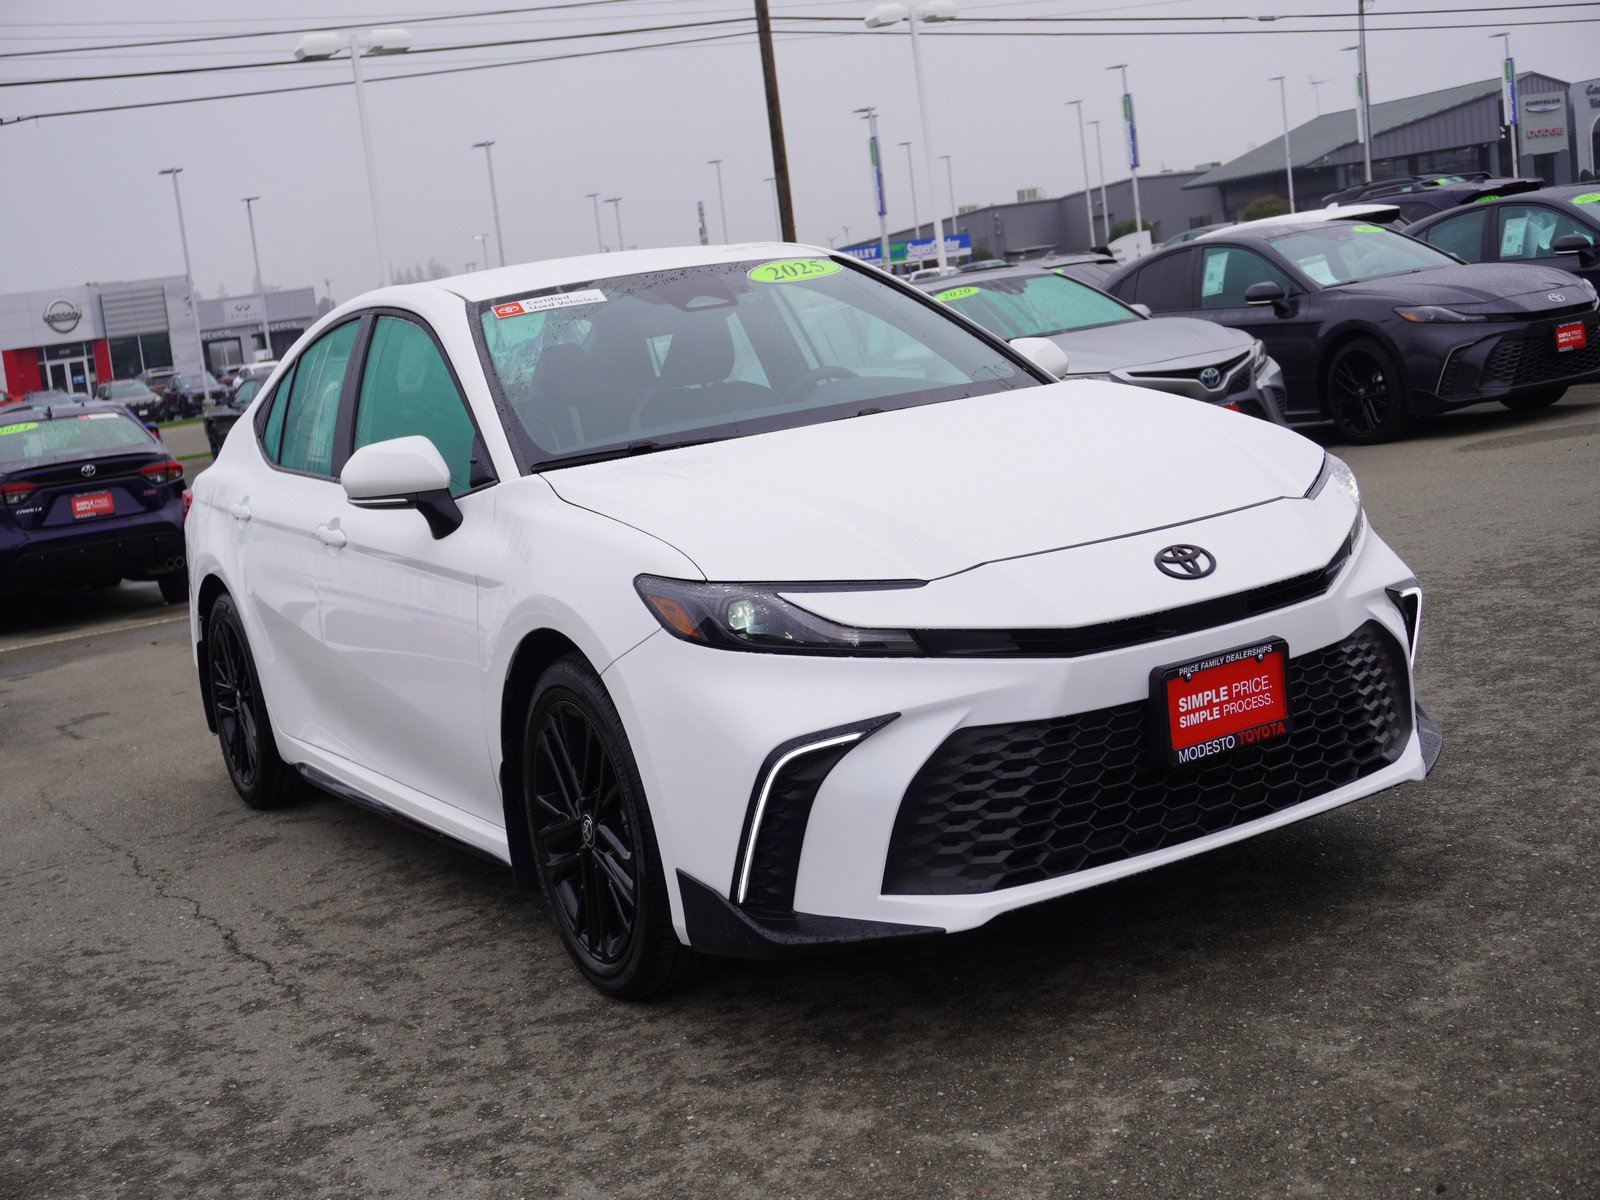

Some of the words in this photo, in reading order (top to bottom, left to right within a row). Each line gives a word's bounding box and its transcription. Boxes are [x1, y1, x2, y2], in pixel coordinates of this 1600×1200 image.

[1527, 127, 1564, 138] DODGE
[766, 259, 824, 280] 2025
[943, 287, 971, 299] 2020
[526, 294, 570, 306] Certified
[529, 303, 555, 311] Used
[557, 297, 599, 308] Vehicles
[47, 311, 79, 322] NISSAN
[258, 320, 297, 332] Epress
[201, 329, 231, 340] ervice
[1178, 663, 1199, 677] PRICE
[1200, 656, 1225, 671] FAMILY
[1225, 644, 1273, 663] DEALERSHIPS
[1178, 685, 1229, 713] SIMPLE
[1232, 674, 1273, 699] PRICE.
[1178, 706, 1221, 729] SIMPLE
[1223, 692, 1275, 718] PROCESS.
[1178, 735, 1236, 764] MODESTO
[1237, 720, 1287, 746] TOYOTA
